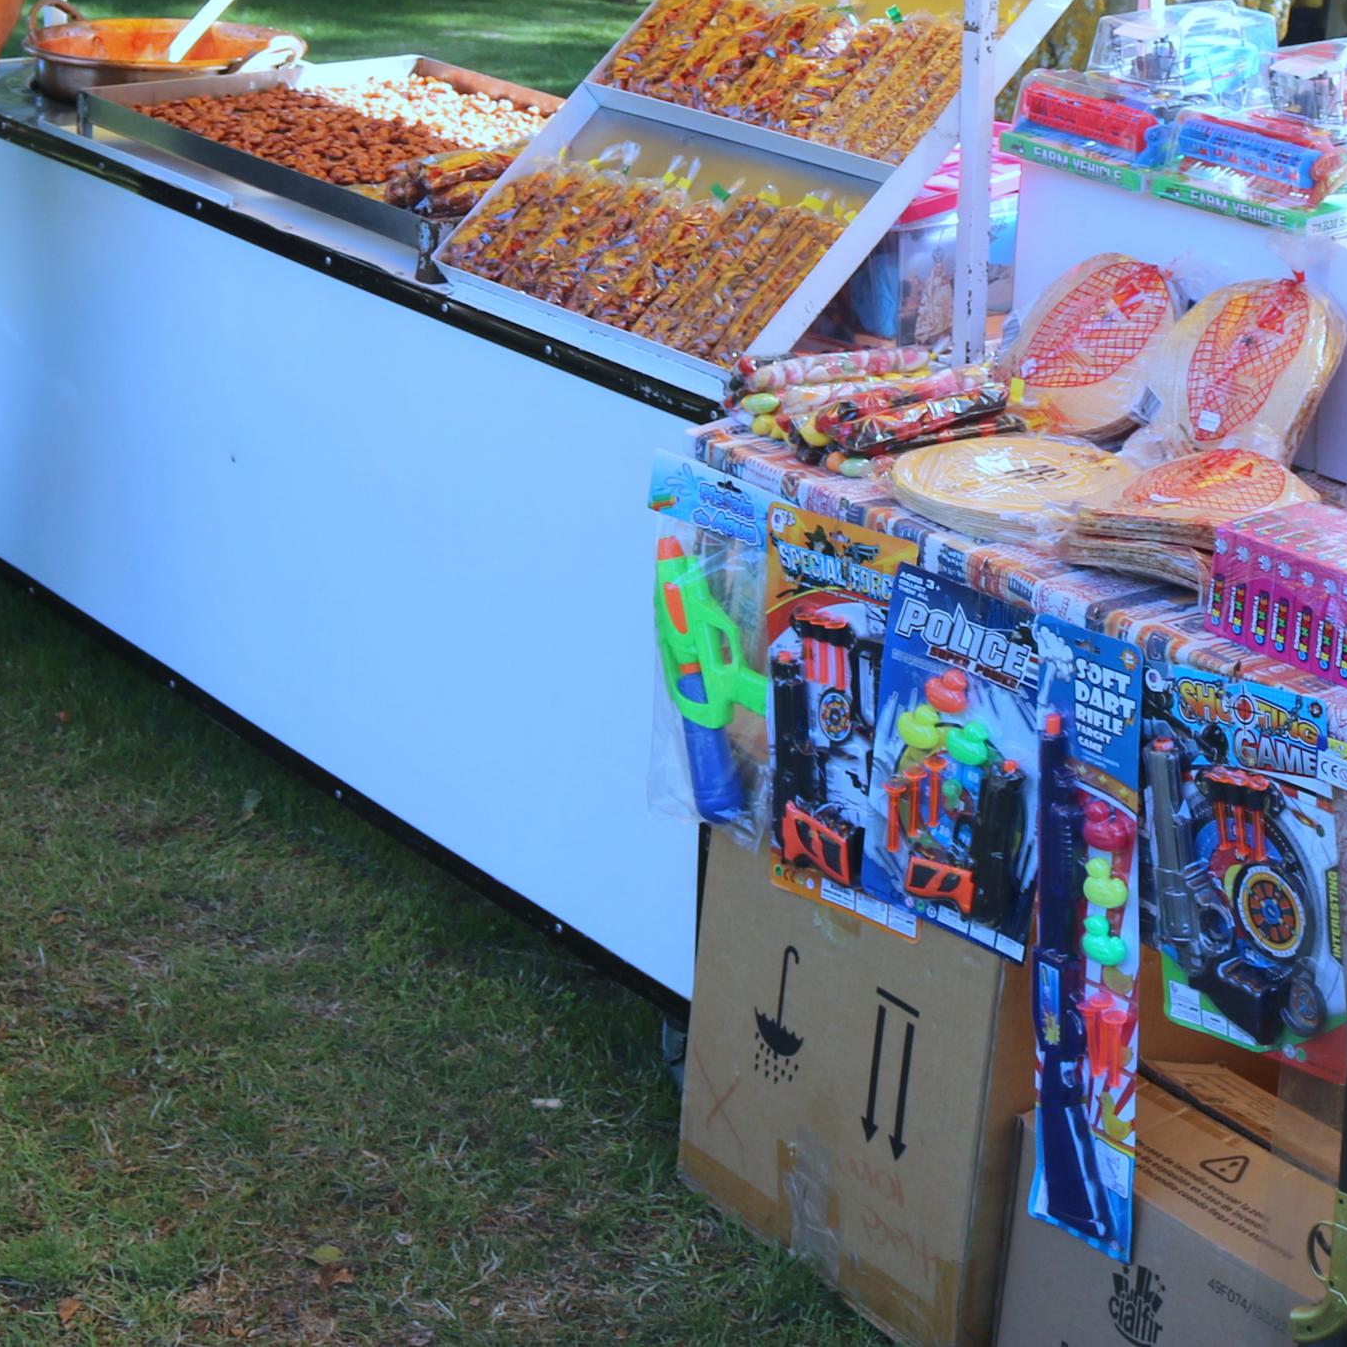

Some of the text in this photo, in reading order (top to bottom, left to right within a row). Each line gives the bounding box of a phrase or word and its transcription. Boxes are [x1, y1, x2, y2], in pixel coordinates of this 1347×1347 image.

[1032, 145, 1124, 185] FARM VEHICLE
[1189, 188, 1287, 227] FARM VEHICLE
[776, 539, 893, 602] SPECIAL FORC
[896, 597, 1032, 681] POLICE
[1075, 657, 1131, 695] SOFT
[1074, 678, 1136, 719] DART
[1074, 702, 1124, 737] RIFLE
[1075, 721, 1112, 745] TARGET
[1077, 735, 1103, 754] GAME
[1234, 727, 1318, 779] GAME
[1327, 870, 1342, 959] INTERESTING
